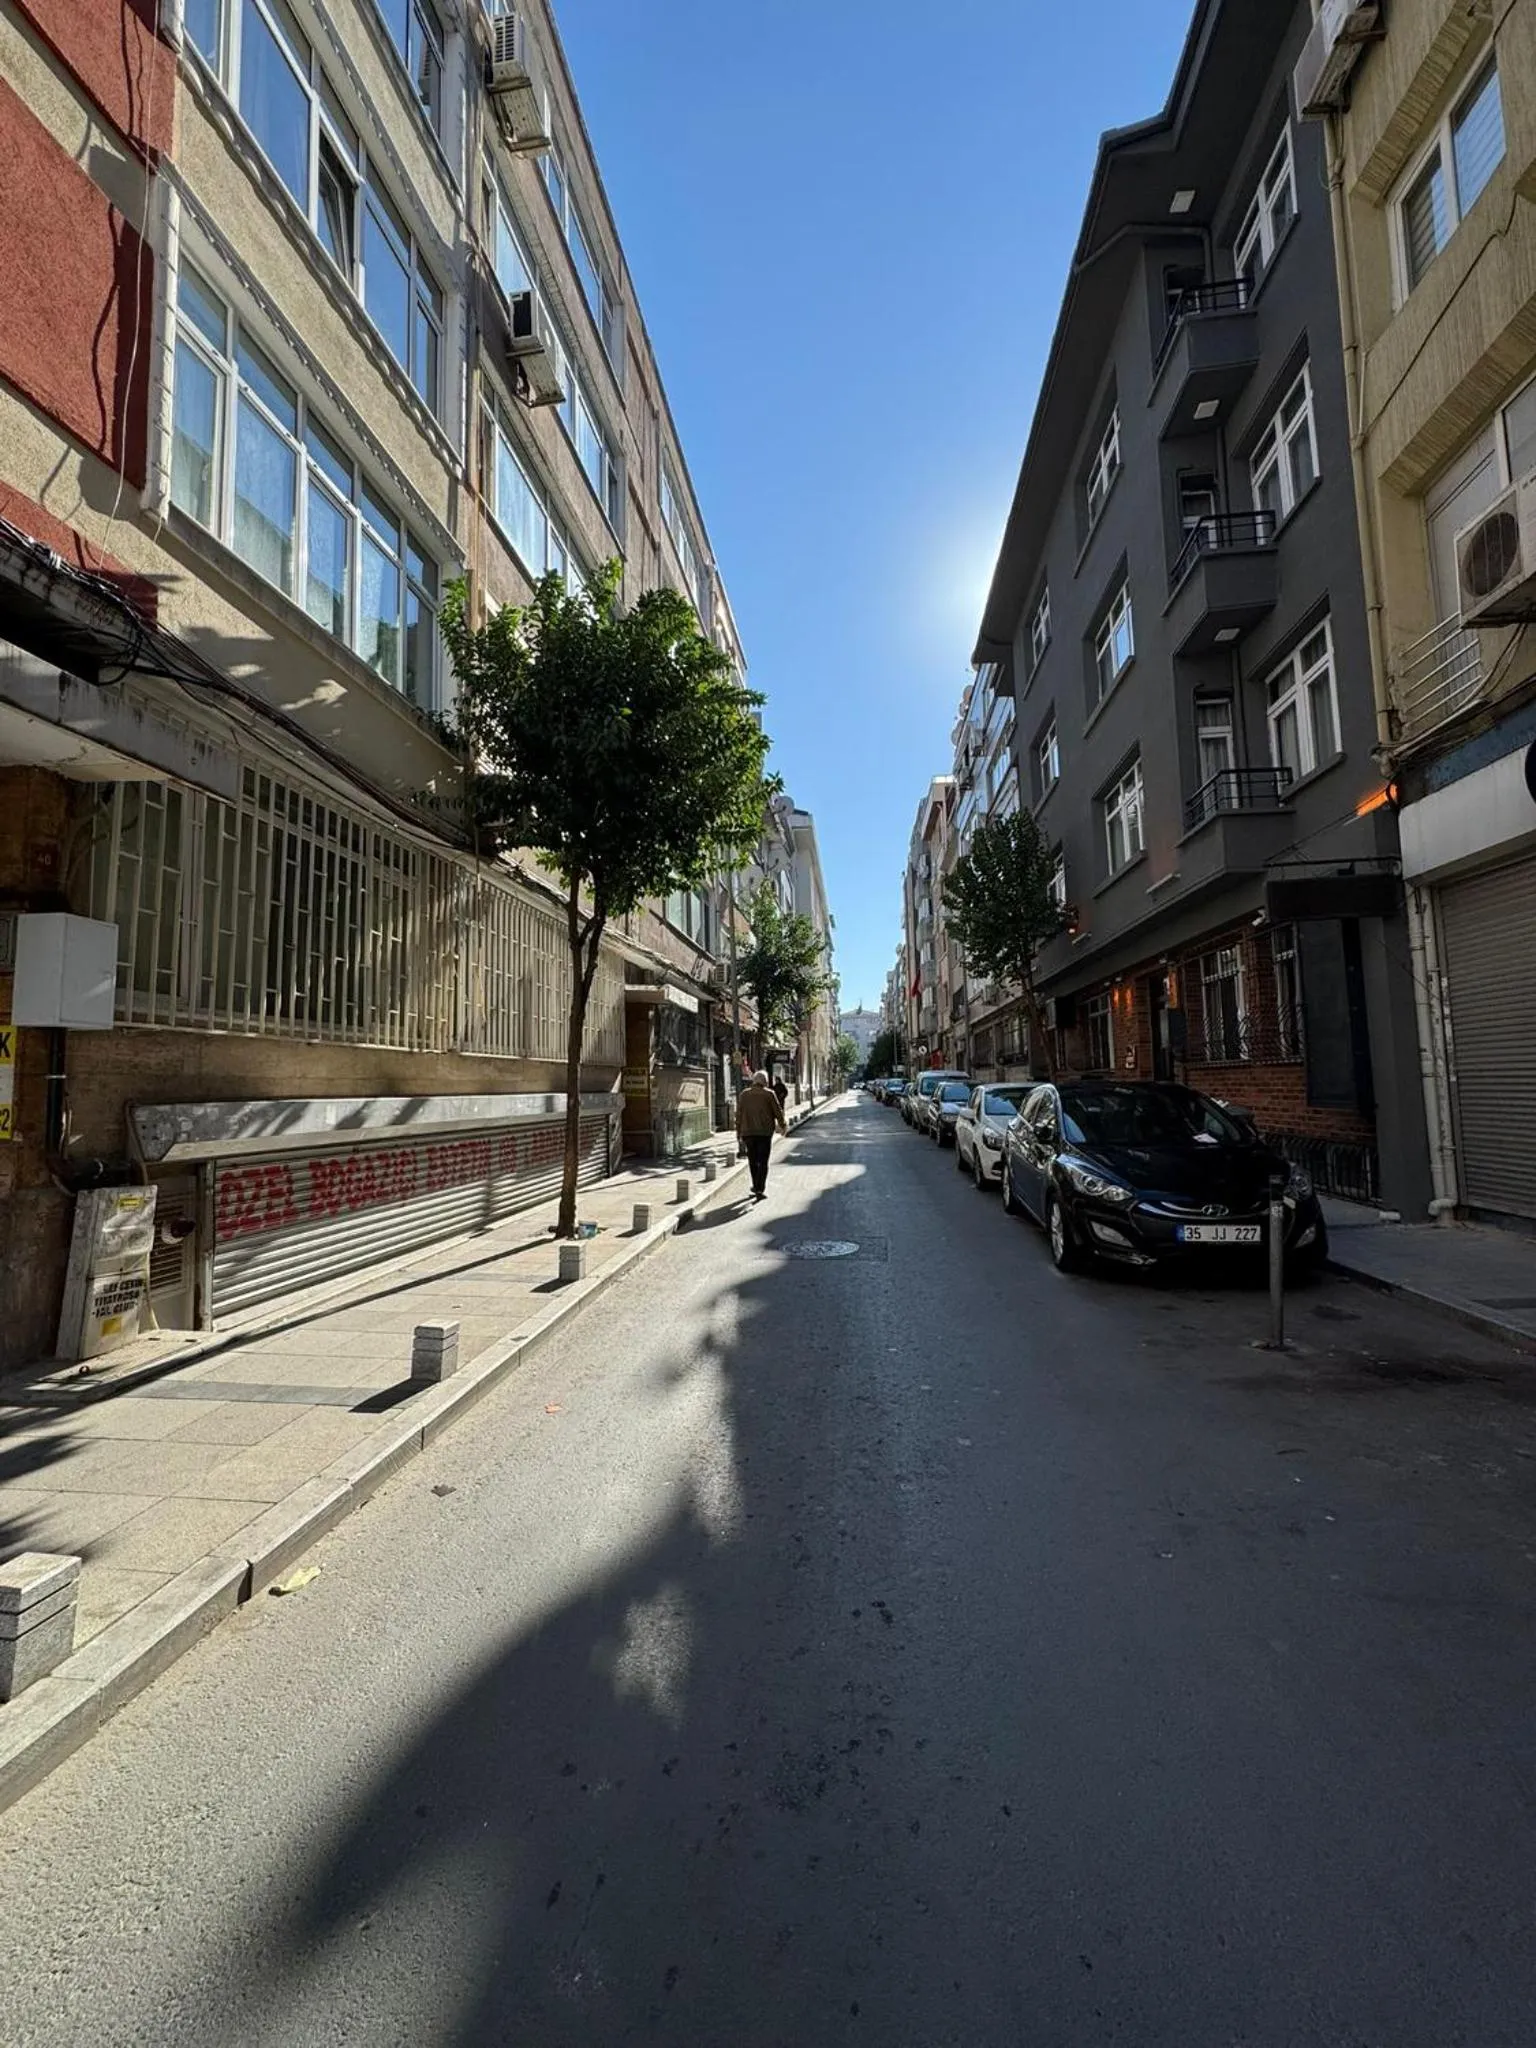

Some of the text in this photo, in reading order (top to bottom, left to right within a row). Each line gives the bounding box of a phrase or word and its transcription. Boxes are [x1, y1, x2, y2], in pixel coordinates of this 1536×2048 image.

[1186, 1227, 1257, 1240] 35 JJ 227
